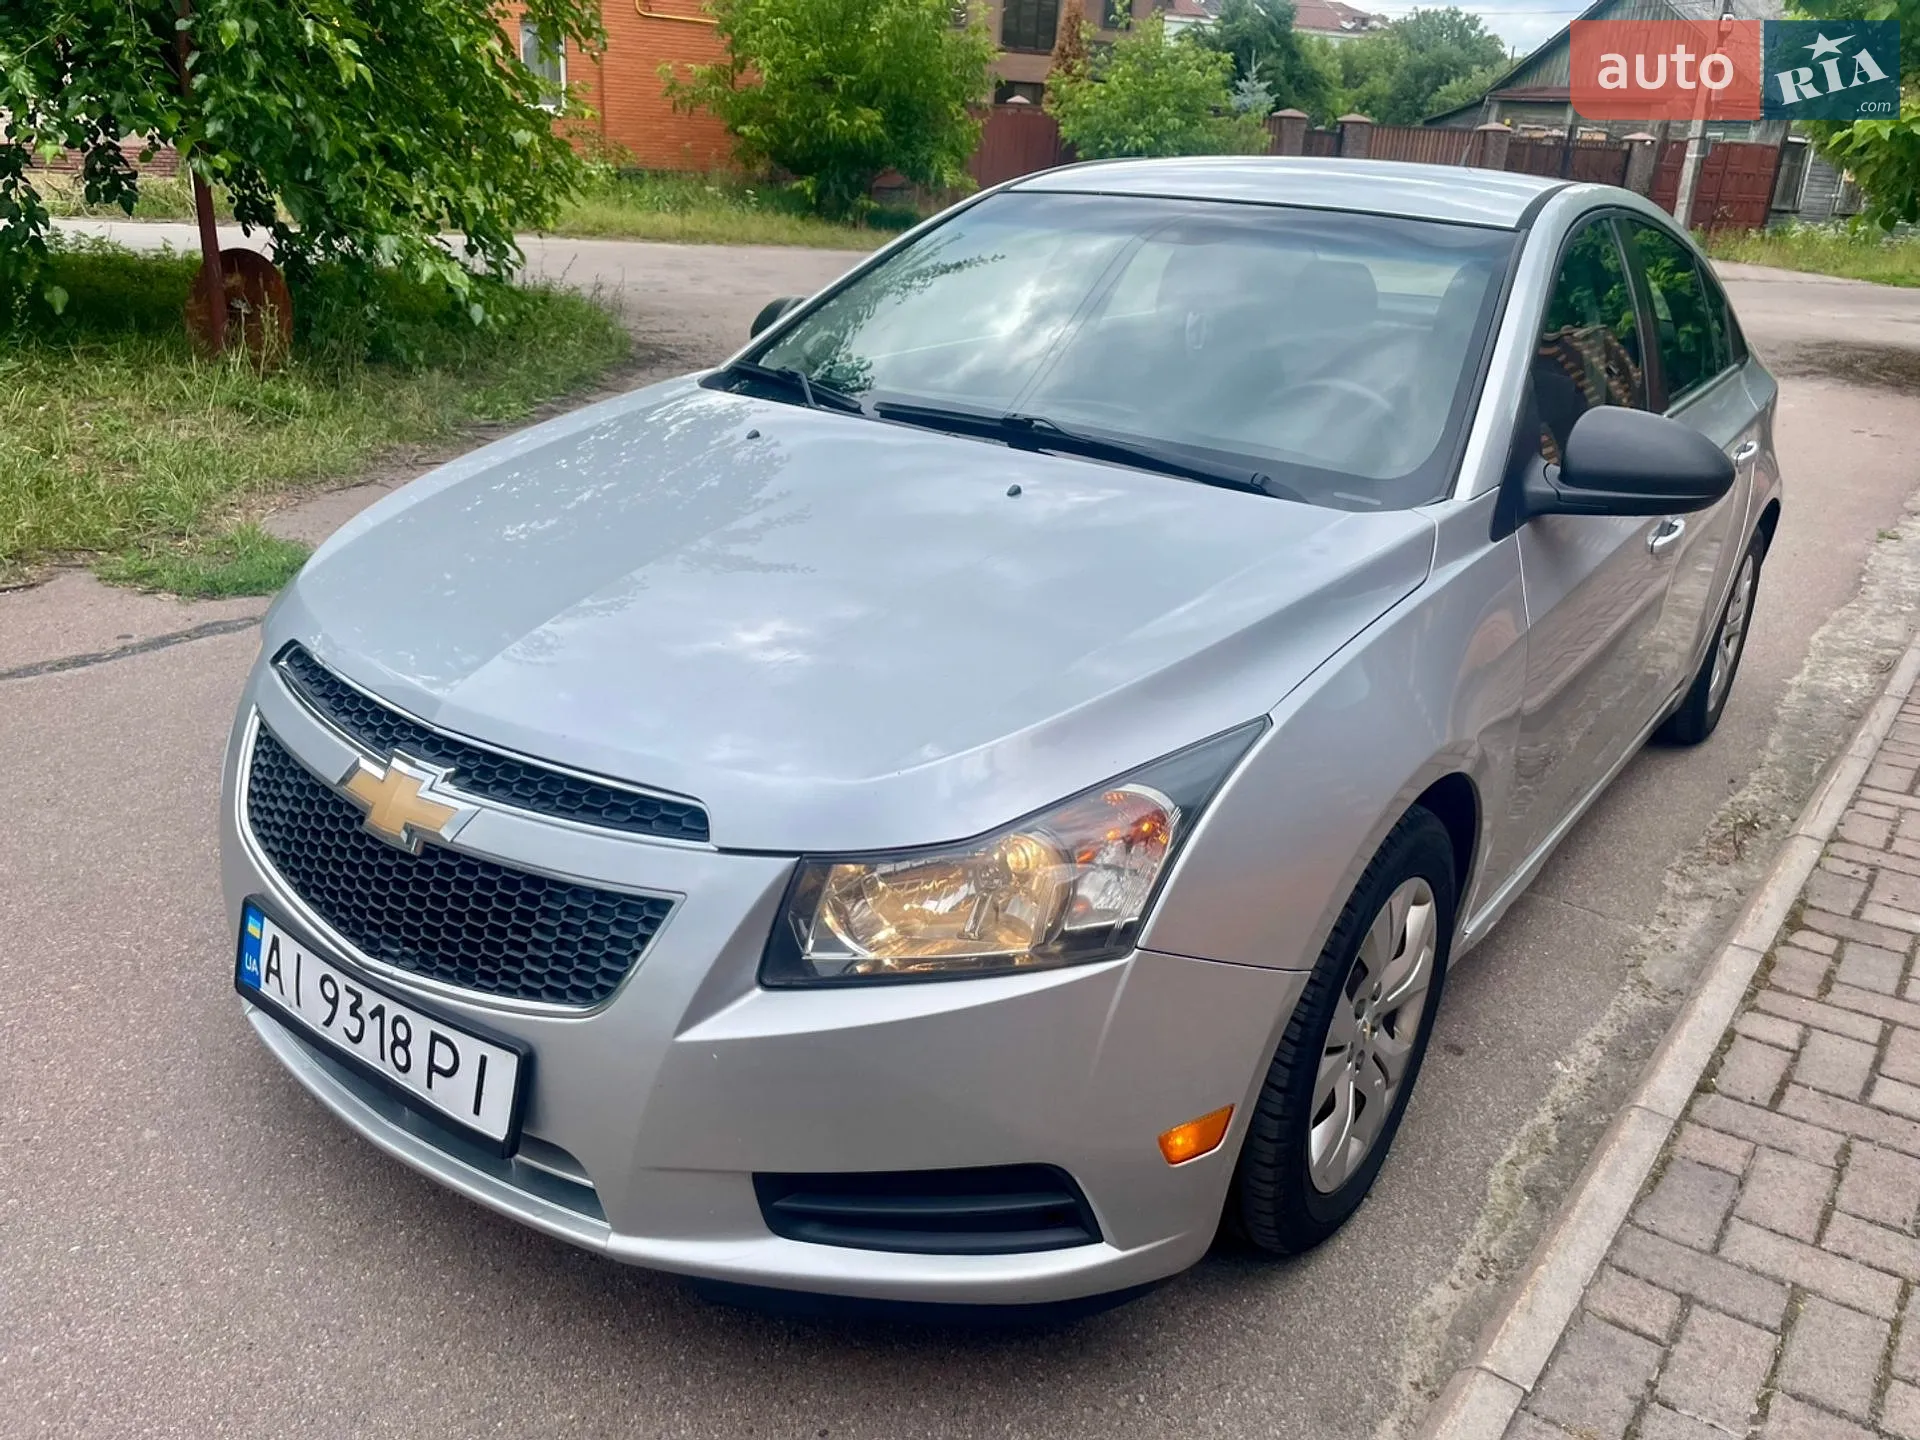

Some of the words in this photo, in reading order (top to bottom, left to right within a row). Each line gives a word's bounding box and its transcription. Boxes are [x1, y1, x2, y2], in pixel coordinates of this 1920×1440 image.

[244, 951, 260, 976] UA
[264, 933, 302, 1008] AI
[319, 973, 412, 1074] 9318
[426, 1029, 488, 1117] PI
